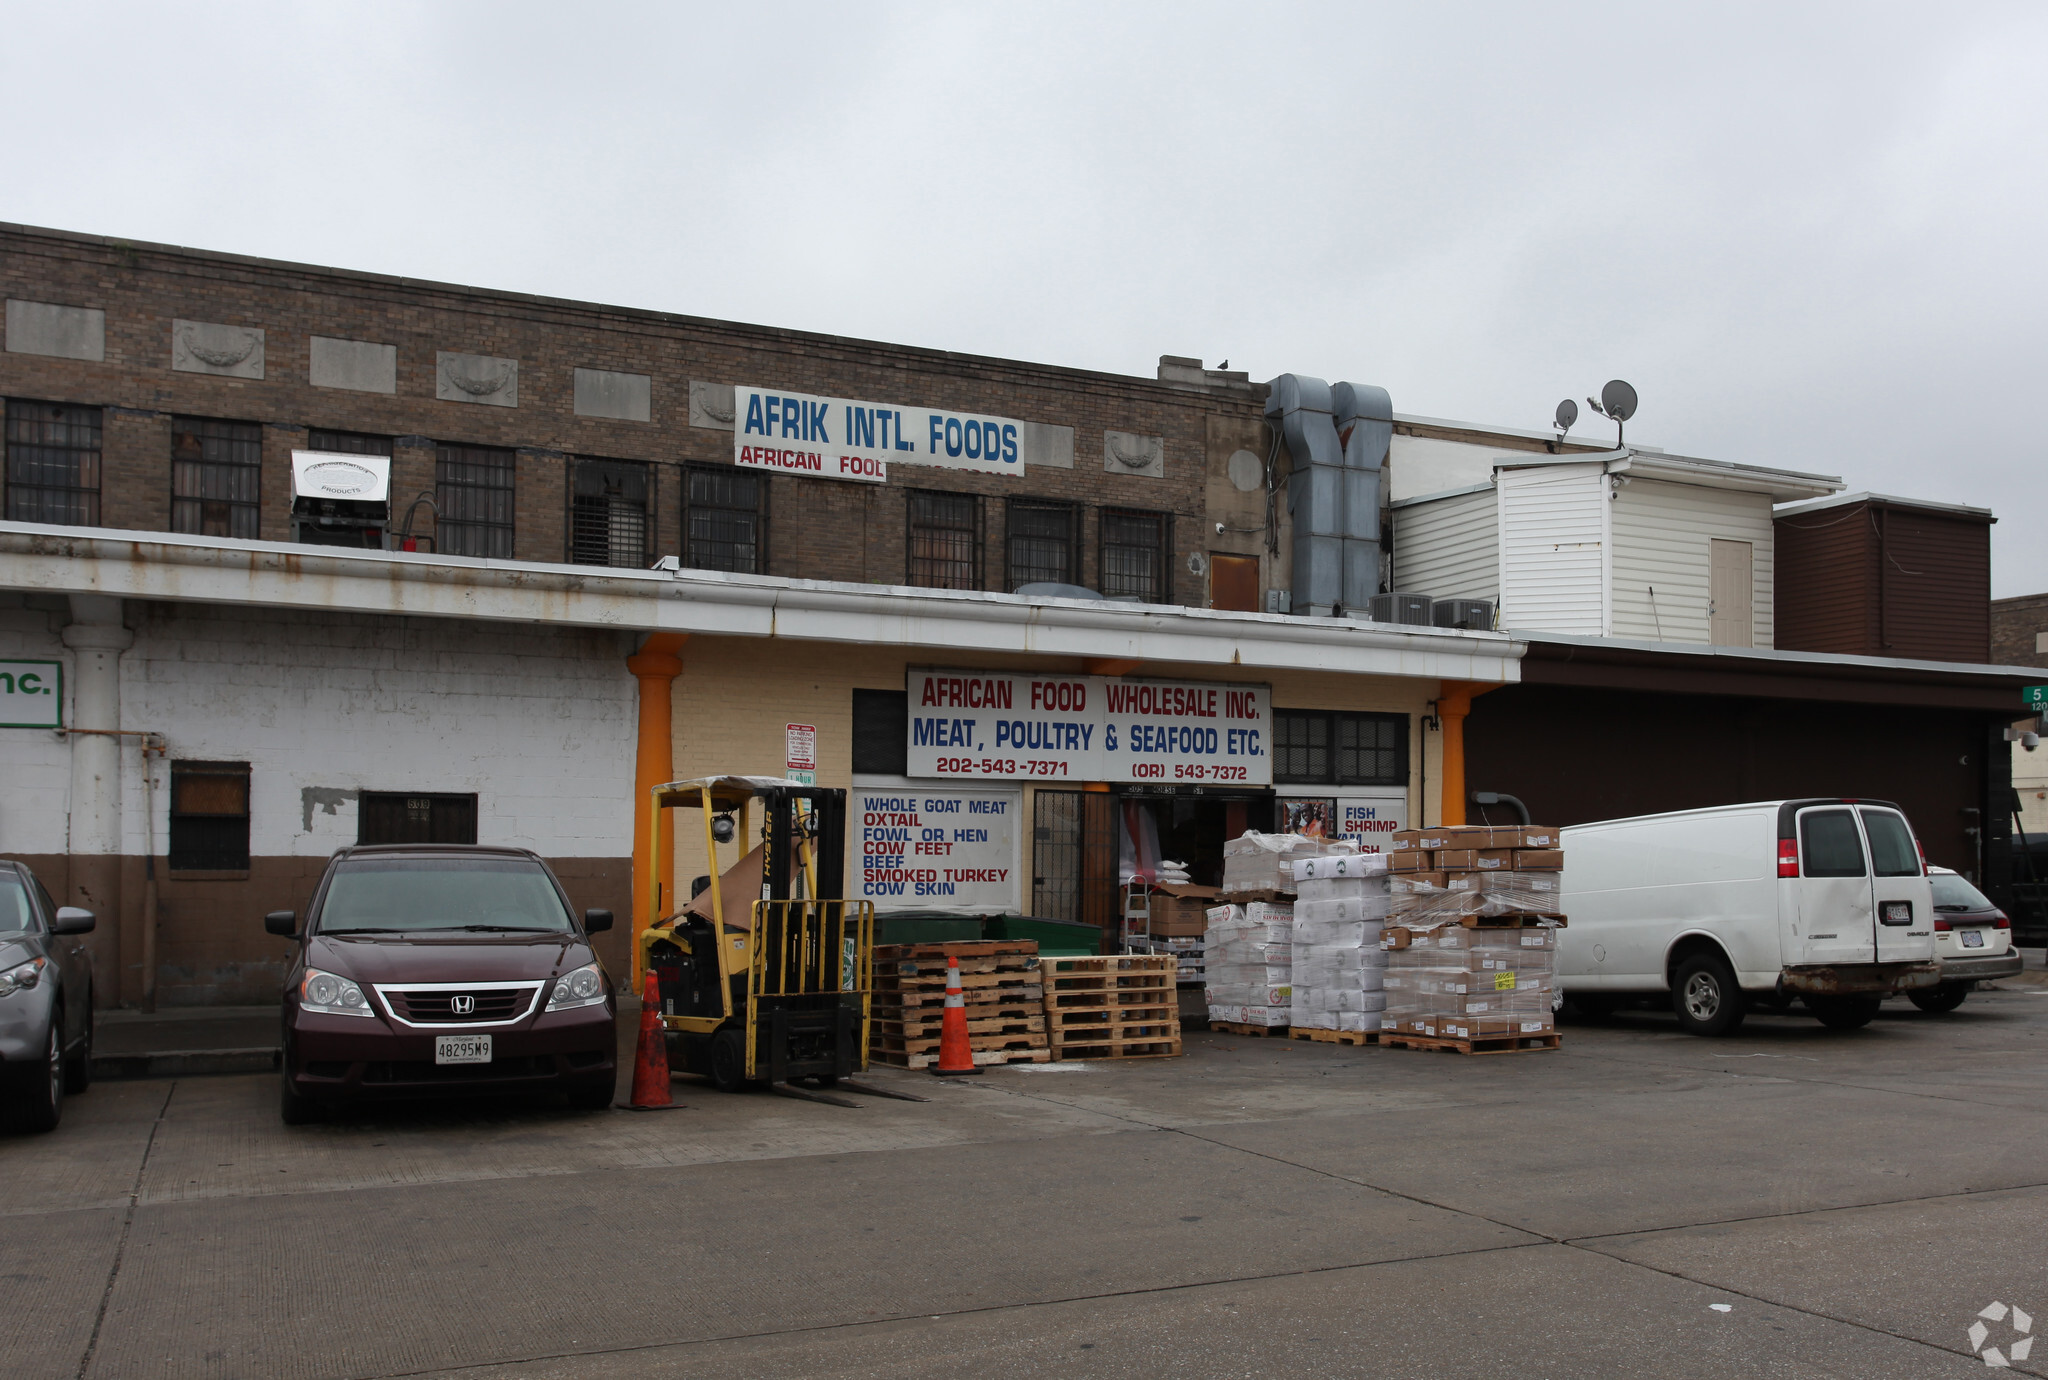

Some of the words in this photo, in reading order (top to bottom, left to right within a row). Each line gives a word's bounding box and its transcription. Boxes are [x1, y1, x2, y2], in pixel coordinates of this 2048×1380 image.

[744, 393, 830, 443] AFRIK
[846, 406, 914, 452] INTL.
[929, 415, 1018, 463] FOODS
[740, 445, 821, 470] AFRICAN
[321, 485, 361, 494] PRODUCTS
[921, 677, 1012, 709] AFRICAN
[1031, 681, 1086, 711] FOOD
[1106, 684, 1217, 717] WHOLESALE
[1225, 691, 1260, 719] INC.
[2033, 688, 2042, 701] 5
[996, 720, 1094, 751] POULTRY
[1105, 723, 1119, 751] &
[1130, 724, 1218, 754] SEAFOOD
[1227, 728, 1264, 755] ETC.
[1132, 763, 1165, 778] (OR)
[1174, 764, 1247, 780] 543-7372
[796, 775, 811, 784] HOUR
[864, 798, 916, 812] WHOLE
[925, 799, 961, 813] GOAT
[969, 801, 1007, 814] MEAT
[1346, 807, 1375, 819] FISH
[864, 813, 922, 826] OXTAIL
[1345, 820, 1397, 832] SHRIMP
[864, 828, 912, 841] FOWL
[922, 828, 944, 841] OR
[954, 829, 987, 842] HEN
[764, 811, 772, 876] HYSTER
[864, 841, 905, 854] COW
[915, 842, 953, 855] FEET
[864, 855, 904, 868] BEEF
[864, 869, 937, 882] SMOKED
[944, 869, 1008, 882] TURKEY
[864, 882, 905, 895] COW
[915, 882, 955, 895] SKIN
[439, 1042, 489, 1057] 48295M9
